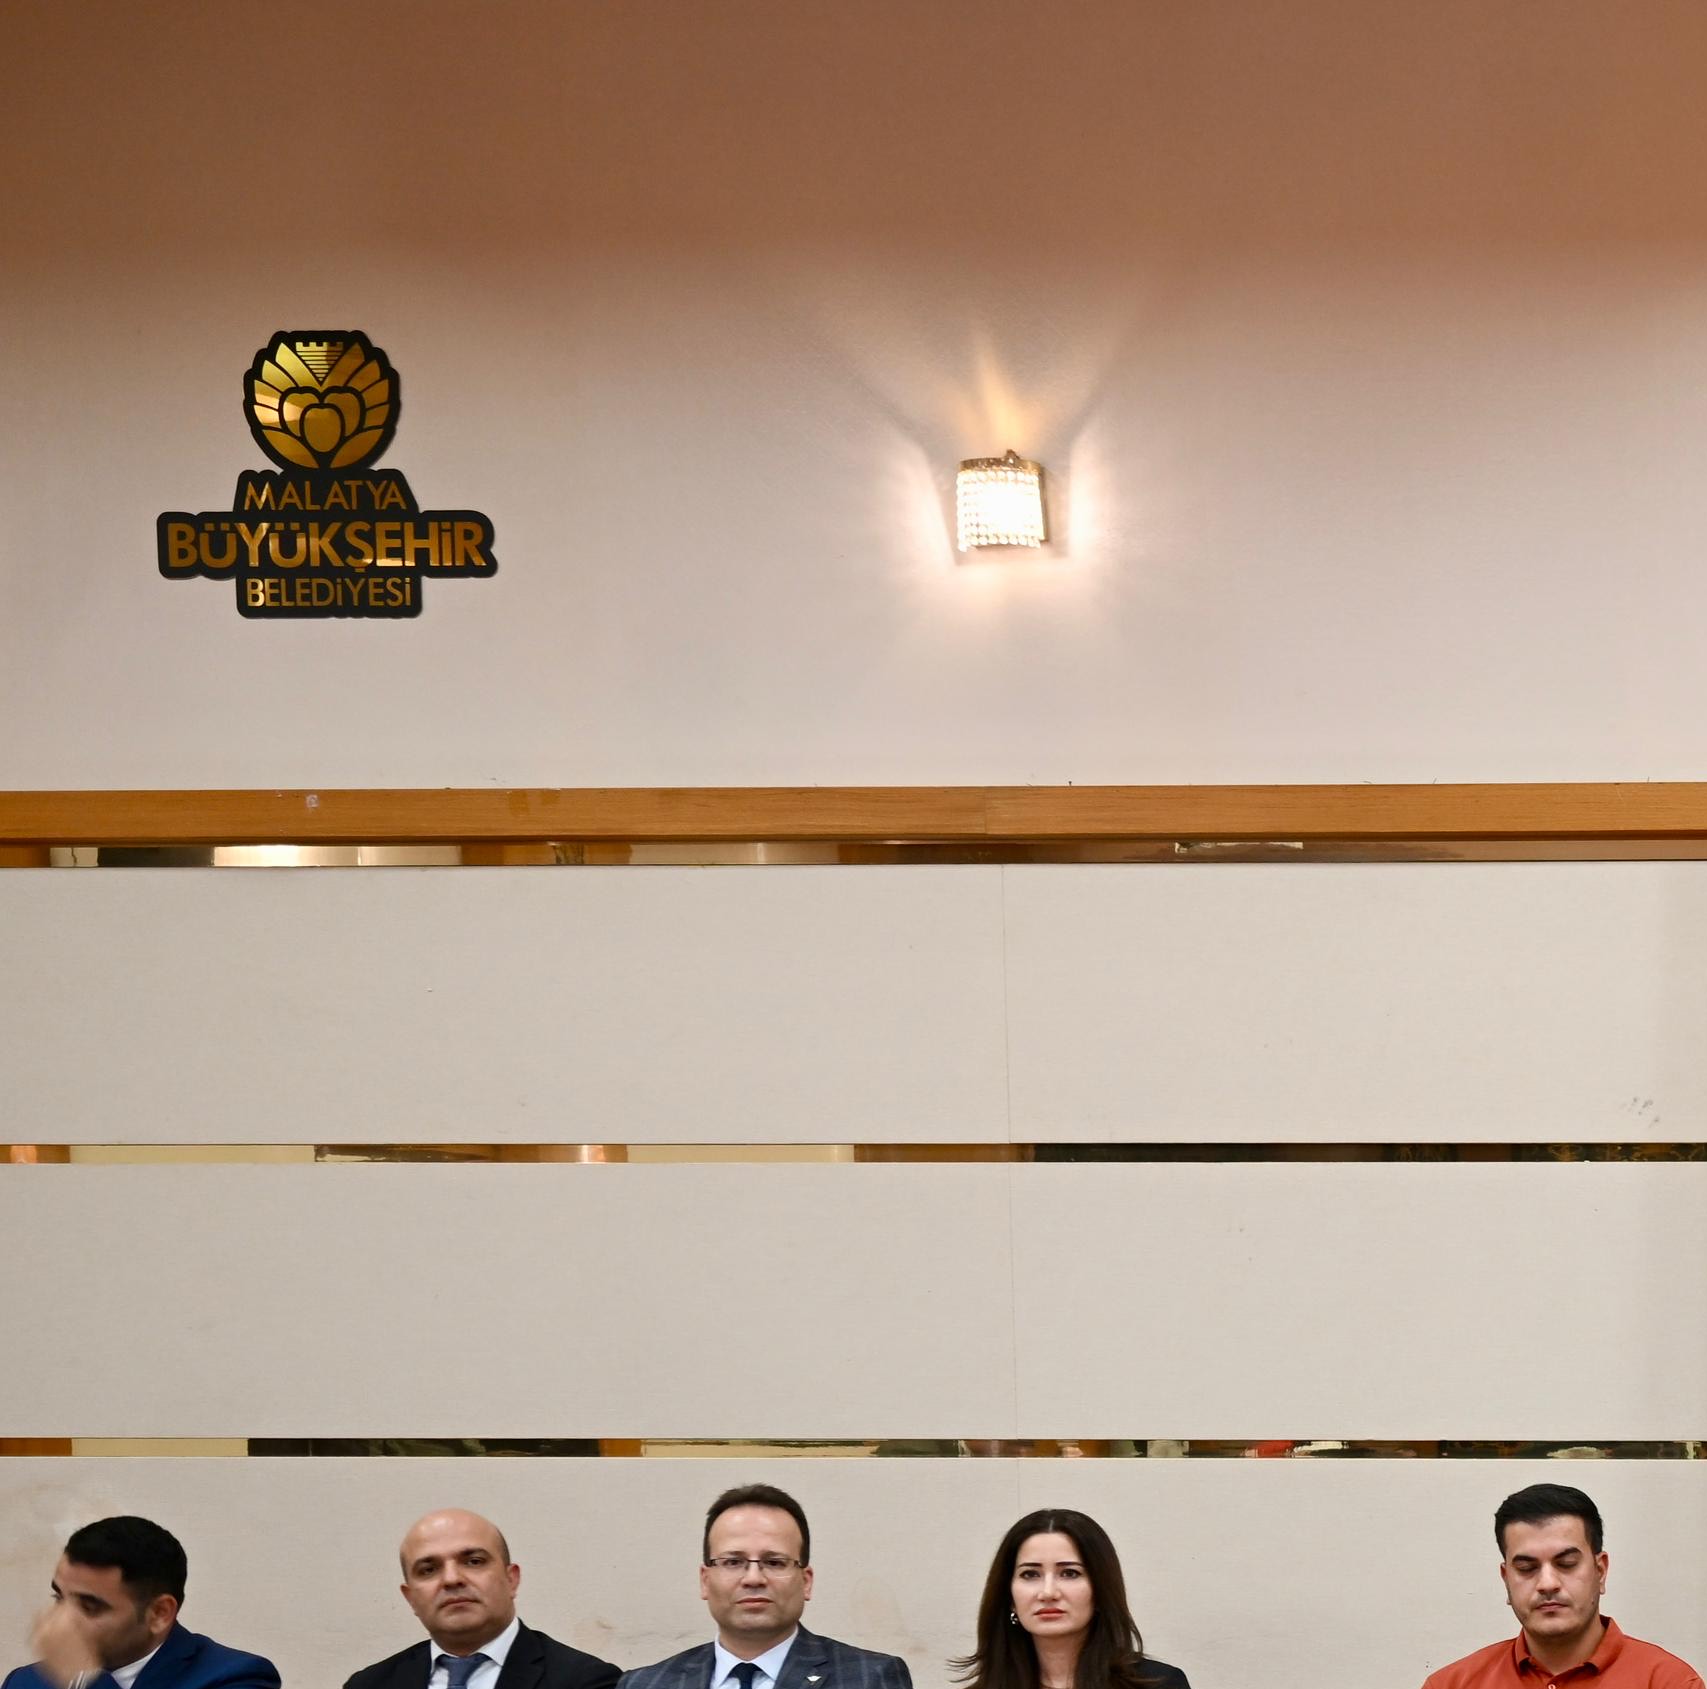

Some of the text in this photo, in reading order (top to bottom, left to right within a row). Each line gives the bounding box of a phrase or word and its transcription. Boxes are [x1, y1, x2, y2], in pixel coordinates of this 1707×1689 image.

[243, 480, 407, 511] MALATYA
[167, 519, 488, 573] BÜYÜKŞEHİR
[246, 576, 412, 607] BELEDİYESİ
